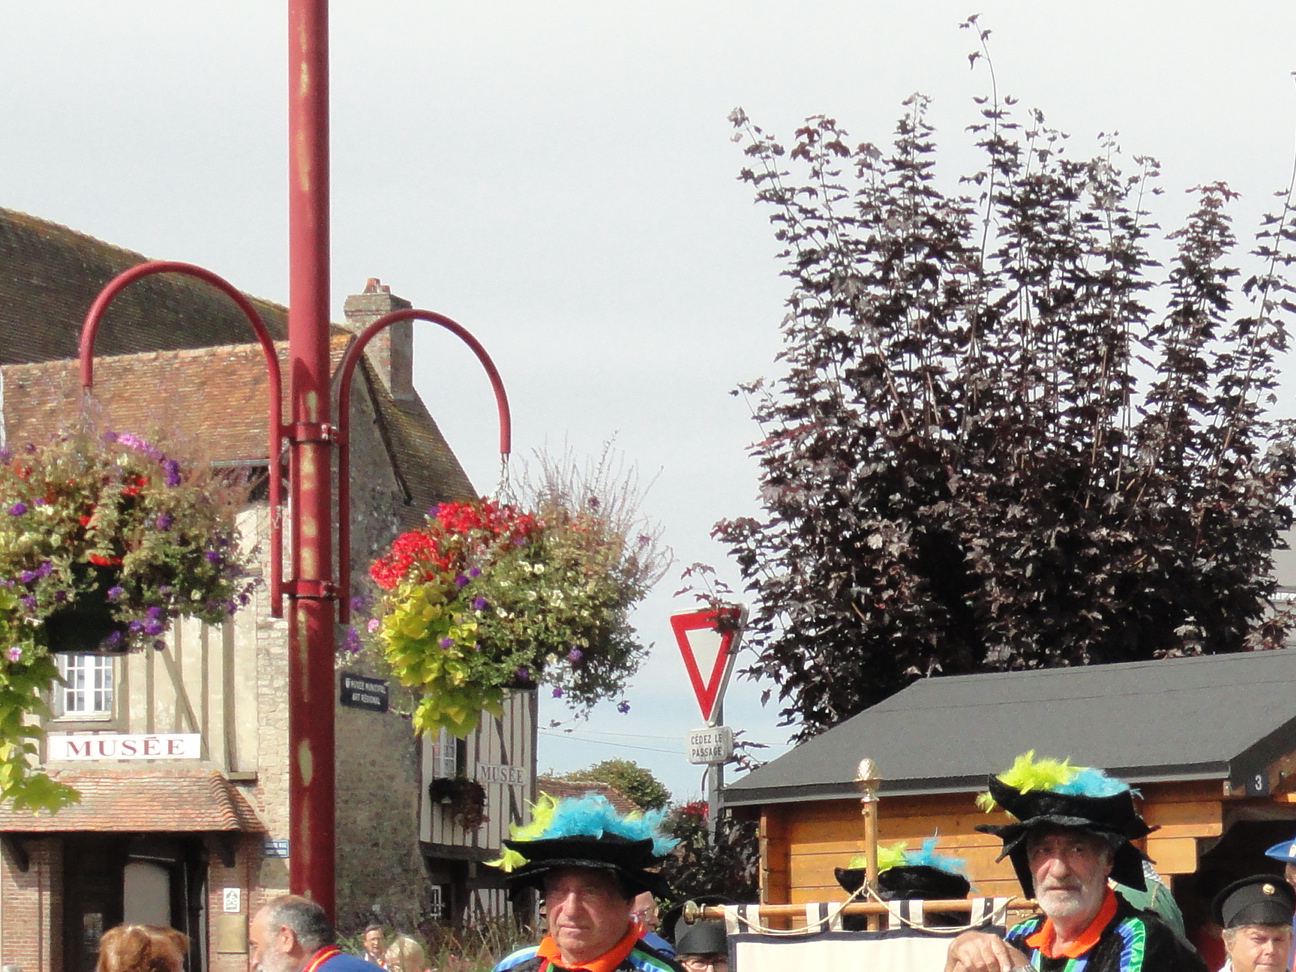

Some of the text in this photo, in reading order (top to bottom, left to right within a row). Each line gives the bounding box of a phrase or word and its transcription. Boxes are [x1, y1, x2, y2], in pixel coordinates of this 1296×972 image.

[690, 733, 723, 745] CÉDEZ LE
[66, 737, 185, 757] MUSÉE
[691, 746, 722, 758] PASSAGE
